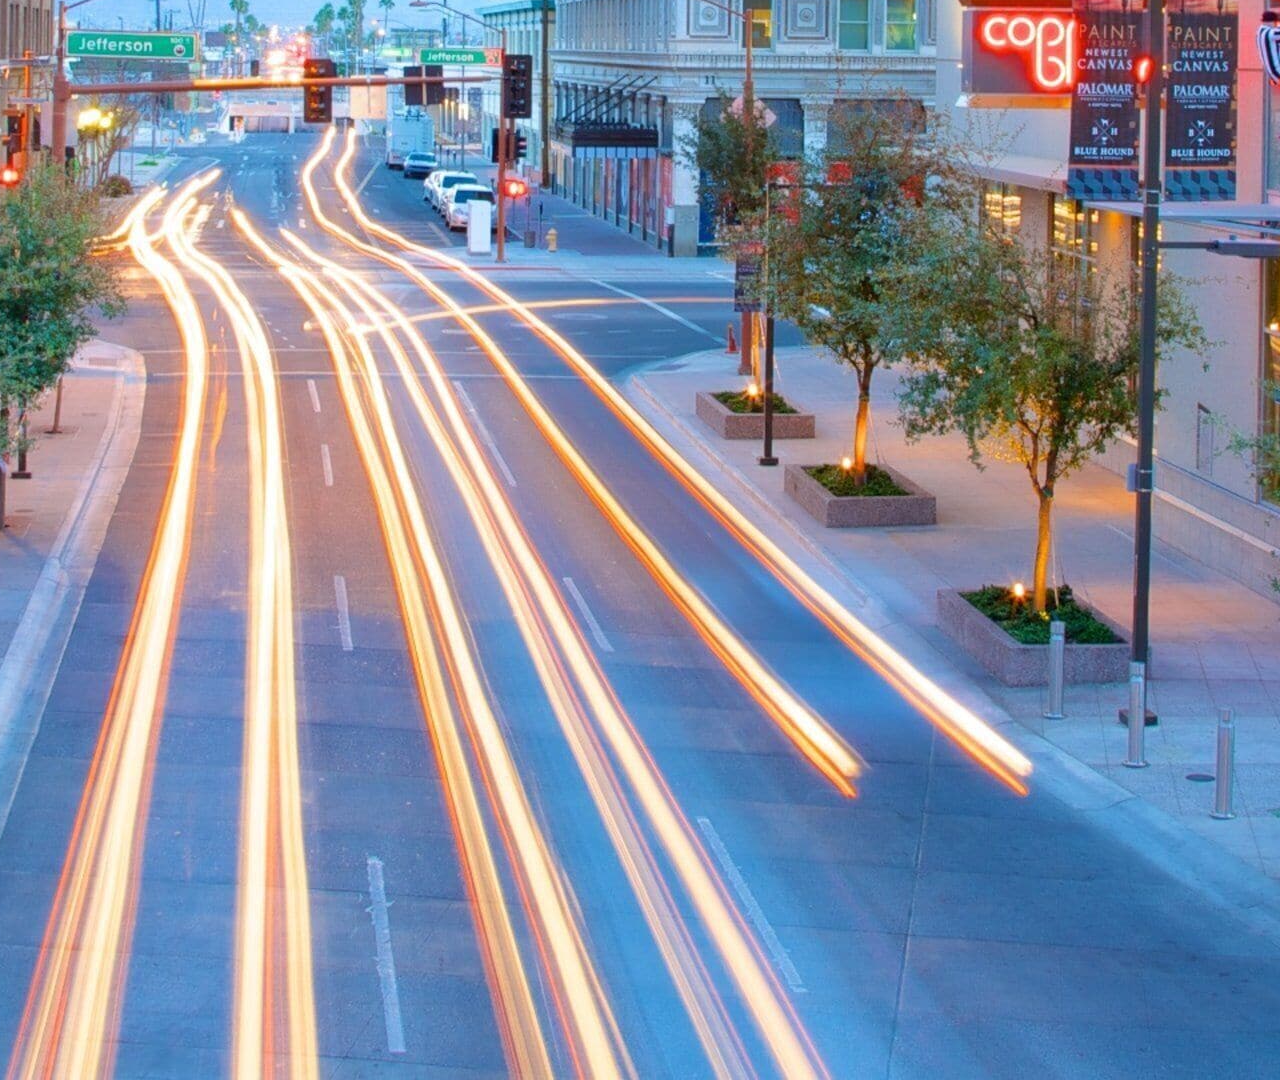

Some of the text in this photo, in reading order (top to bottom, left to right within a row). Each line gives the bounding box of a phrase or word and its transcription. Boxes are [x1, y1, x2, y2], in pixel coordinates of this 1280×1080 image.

[1079, 24, 1137, 39] PAINT
[1173, 26, 1232, 41] PAINT
[78, 37, 153, 52] Jefferson
[982, 16, 1073, 62] cop
[427, 53, 474, 62] Jefferson
[1085, 49, 1129, 57] NEWEST
[1181, 50, 1225, 59] NEWEST
[1077, 60, 1133, 71] CANVAS
[1173, 61, 1229, 73] CANVAS
[1077, 83, 1133, 95] PALOMAR
[1173, 84, 1230, 97] PALOMAR
[1074, 146, 1134, 156] BLUE HOUND
[1171, 148, 1231, 158] BLUE HOUND
